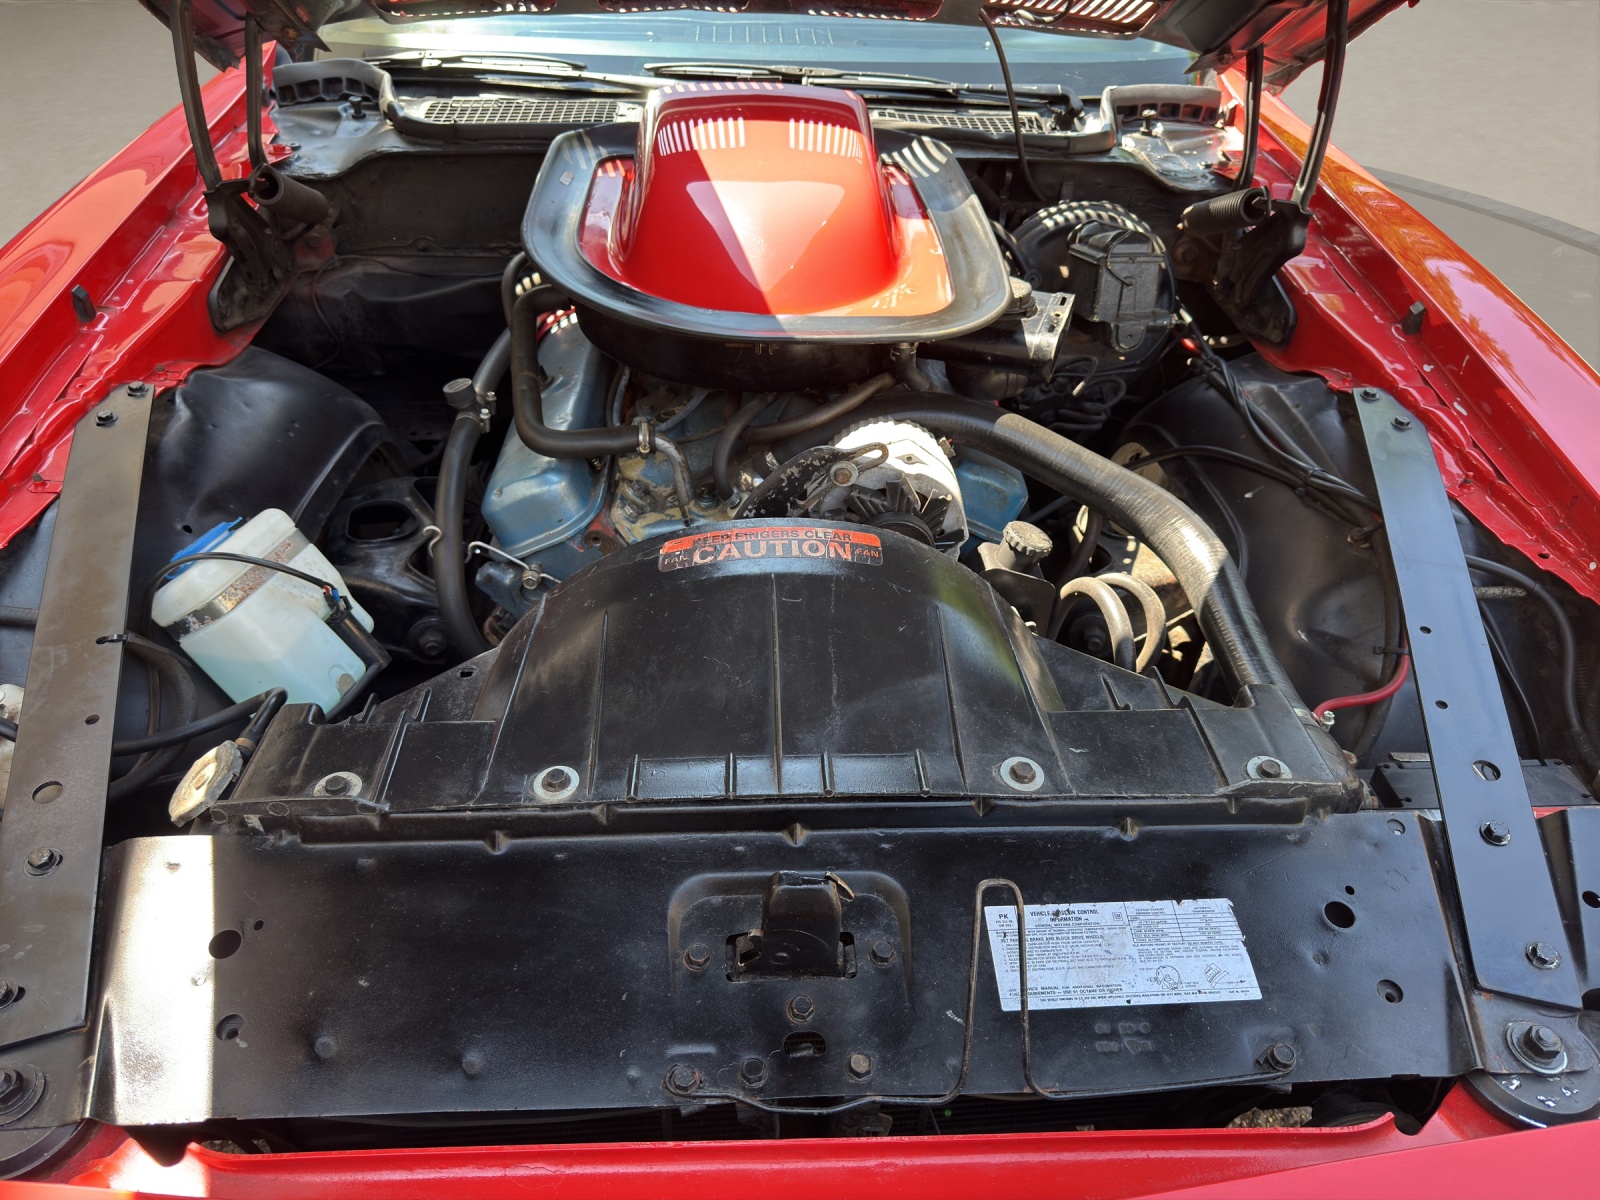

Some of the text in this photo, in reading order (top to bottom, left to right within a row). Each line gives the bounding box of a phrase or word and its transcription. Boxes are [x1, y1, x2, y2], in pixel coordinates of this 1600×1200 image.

[692, 530, 852, 547] KEEP FINGERS CLEAR
[664, 538, 880, 565] FAN CAUTION FAN
